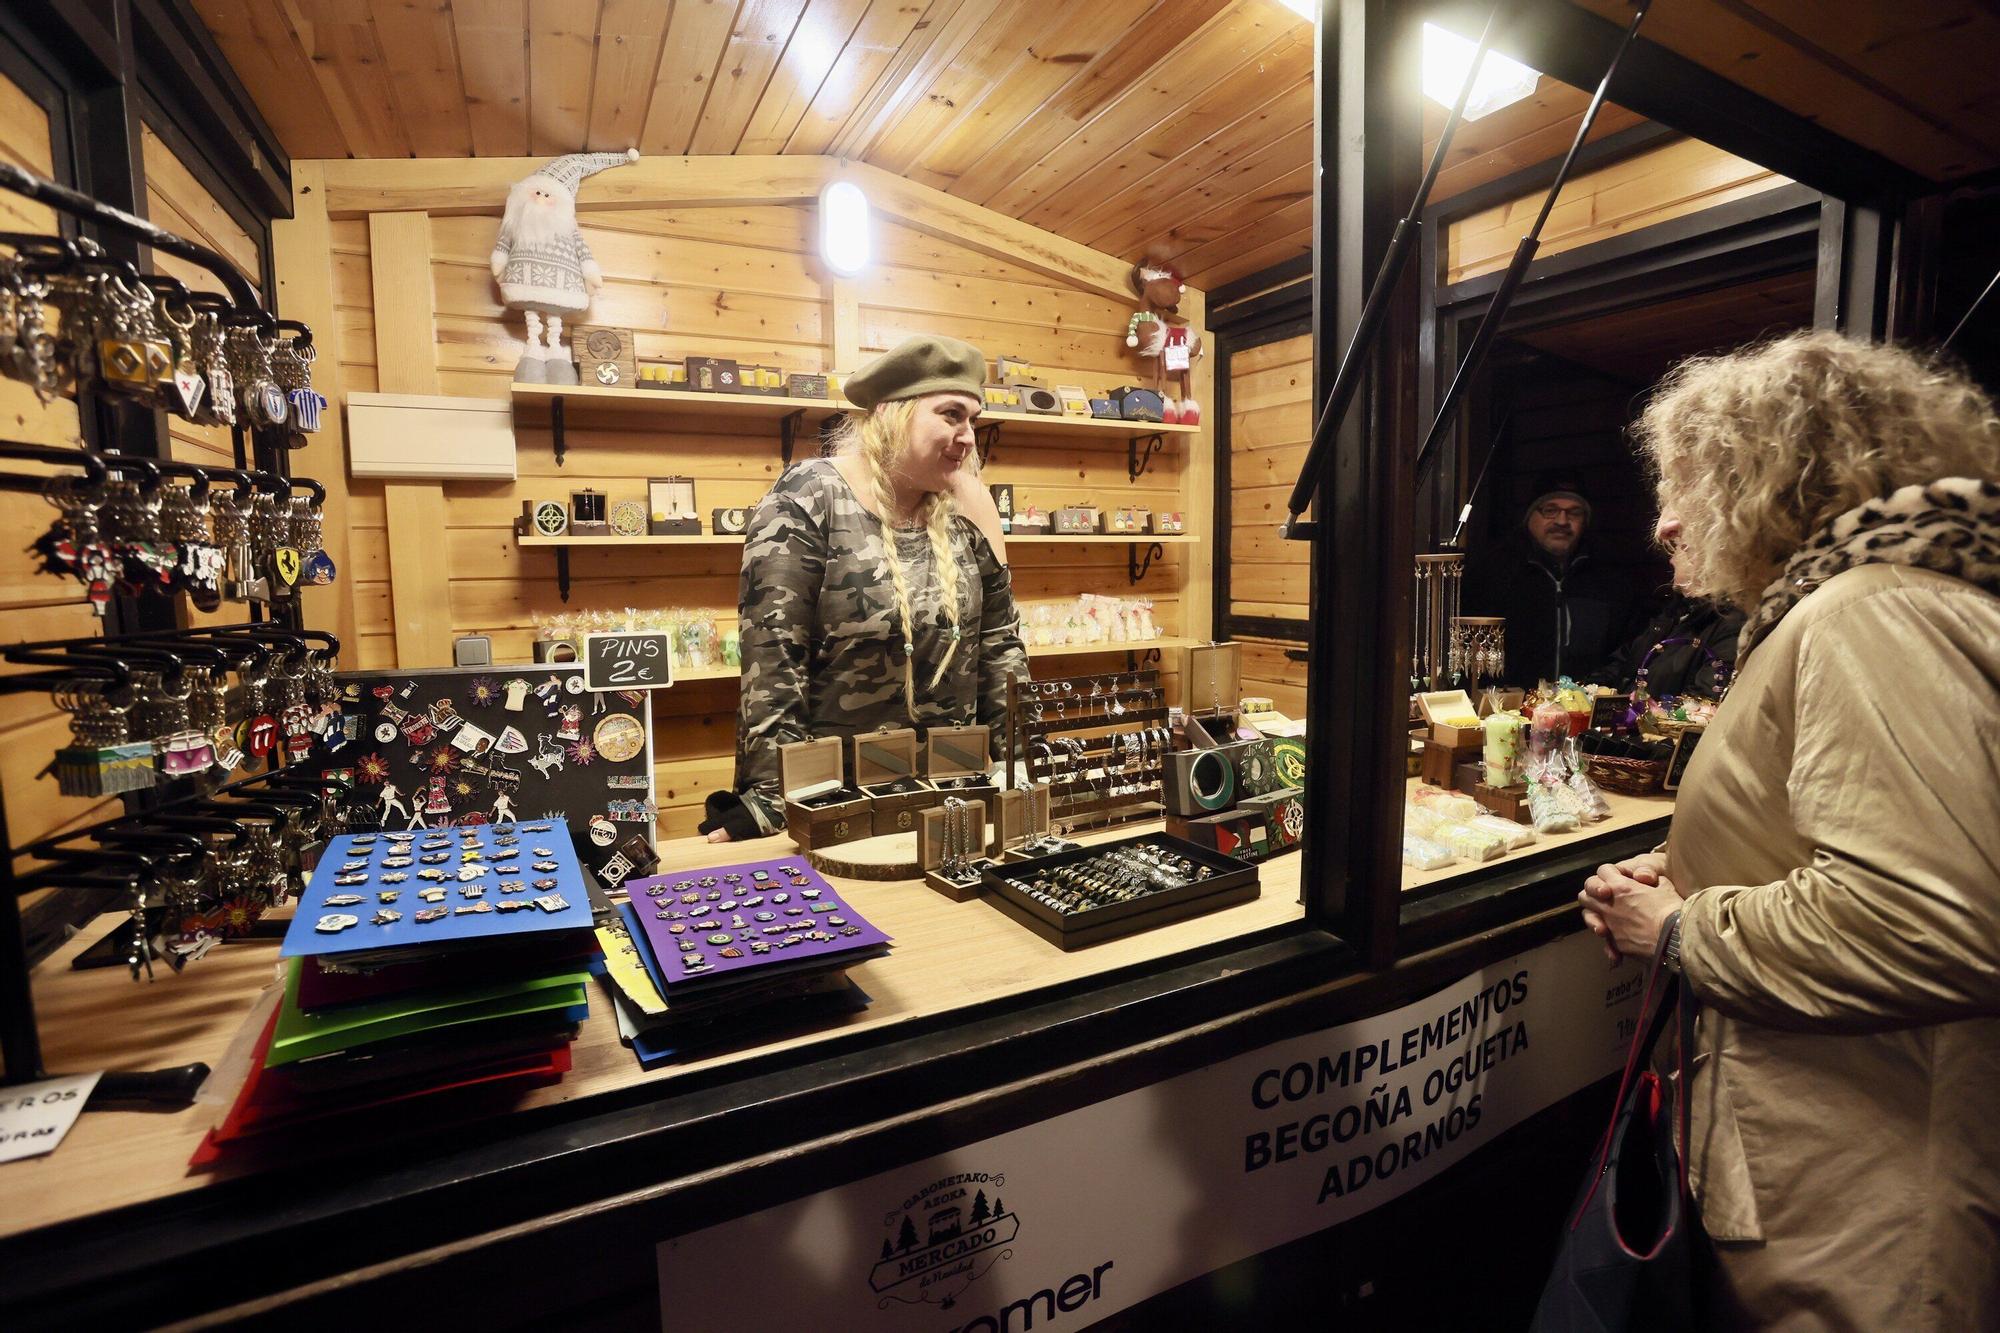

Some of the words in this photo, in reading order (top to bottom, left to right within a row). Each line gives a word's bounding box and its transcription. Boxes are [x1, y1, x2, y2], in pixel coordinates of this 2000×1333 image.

[600, 638, 659, 657] PINS
[609, 660, 653, 682] 2€
[1251, 970, 1528, 1110] COMPLEMENTOS
[1244, 1083, 1412, 1173] BEGOÑA
[1422, 1021, 1528, 1106] OGUETA
[1316, 1094, 1482, 1205] ADORNOS
[903, 1173, 989, 1210] GABONETAKO
[923, 1188, 967, 1210] AZOKA
[899, 1228, 996, 1277] MERCADO
